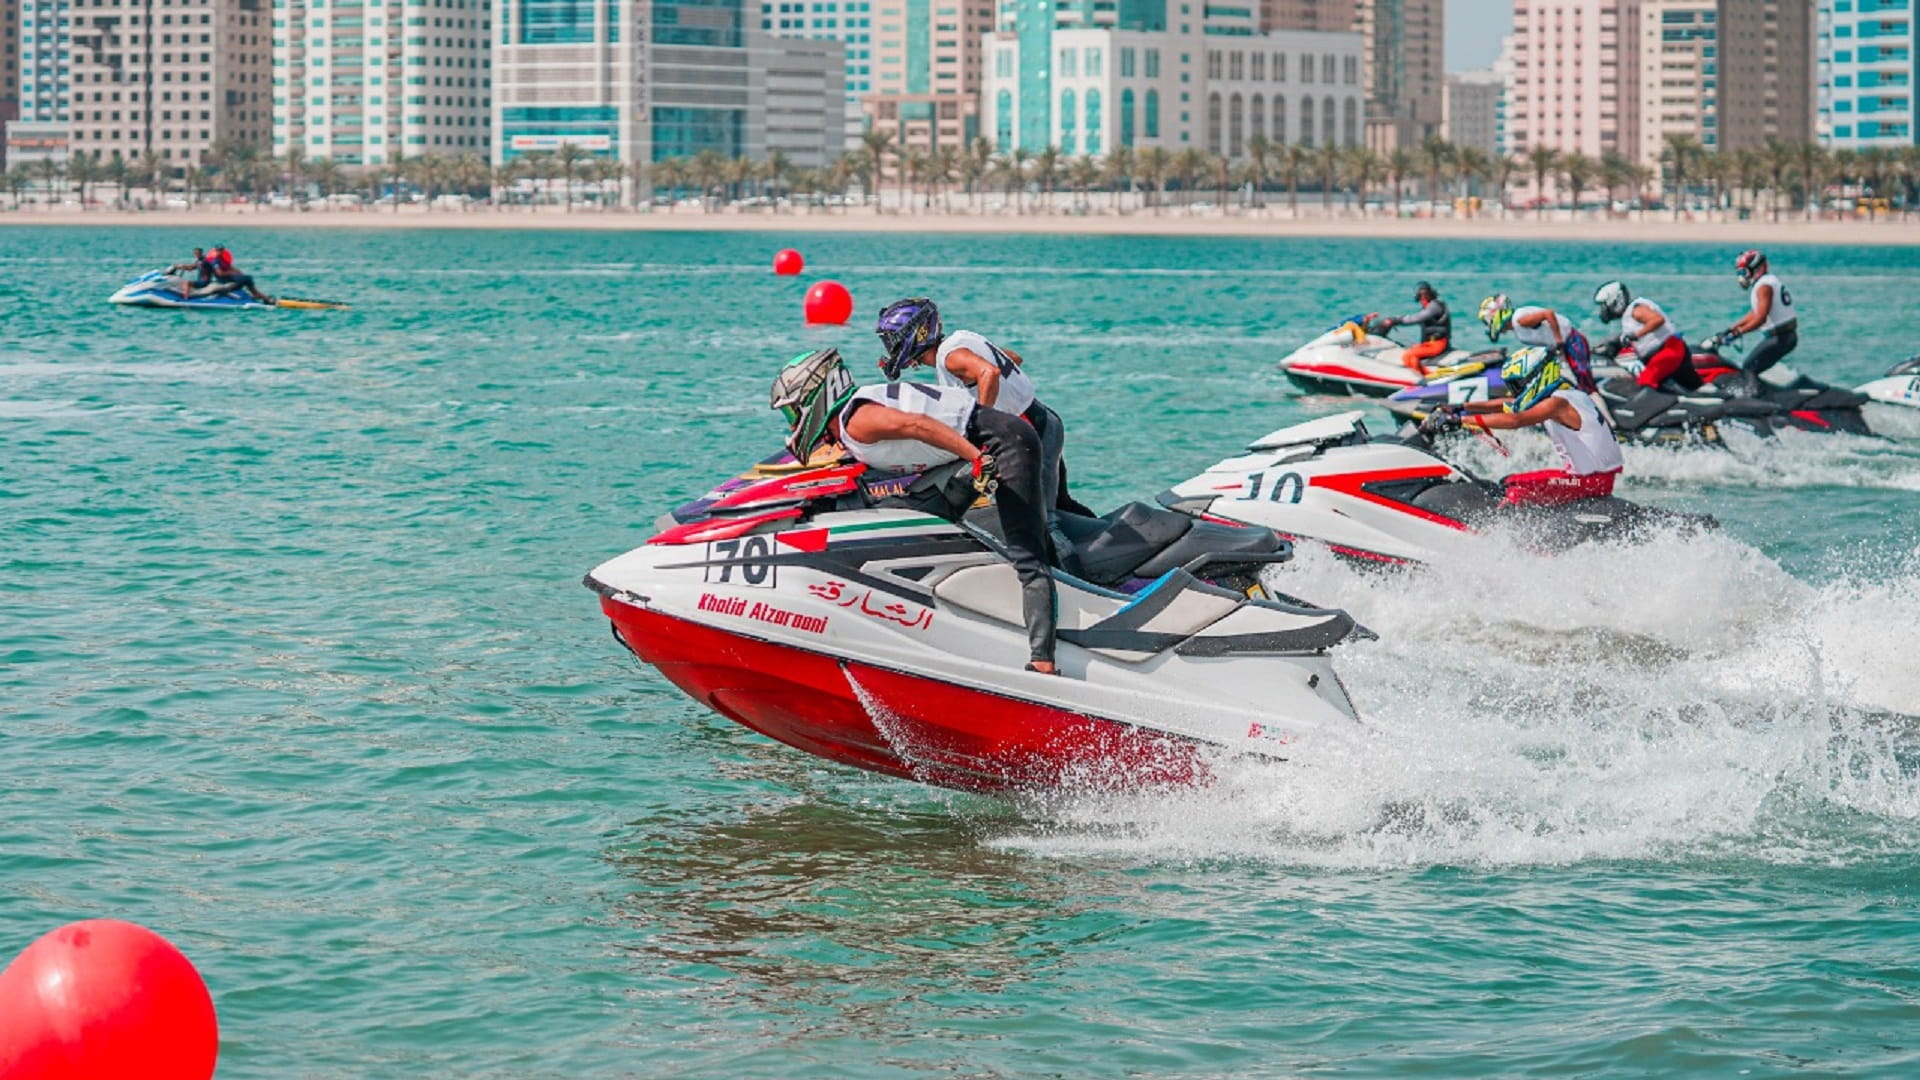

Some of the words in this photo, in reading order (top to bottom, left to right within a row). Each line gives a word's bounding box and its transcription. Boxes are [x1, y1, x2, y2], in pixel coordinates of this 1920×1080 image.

[1780, 284, 1792, 306] 6
[1459, 386, 1478, 403] 7
[1235, 471, 1304, 504] 10
[716, 536, 769, 585] 70
[697, 593, 748, 617] Khalid
[750, 602, 829, 635] Alzarooni
[807, 581, 935, 630] الشارقة
